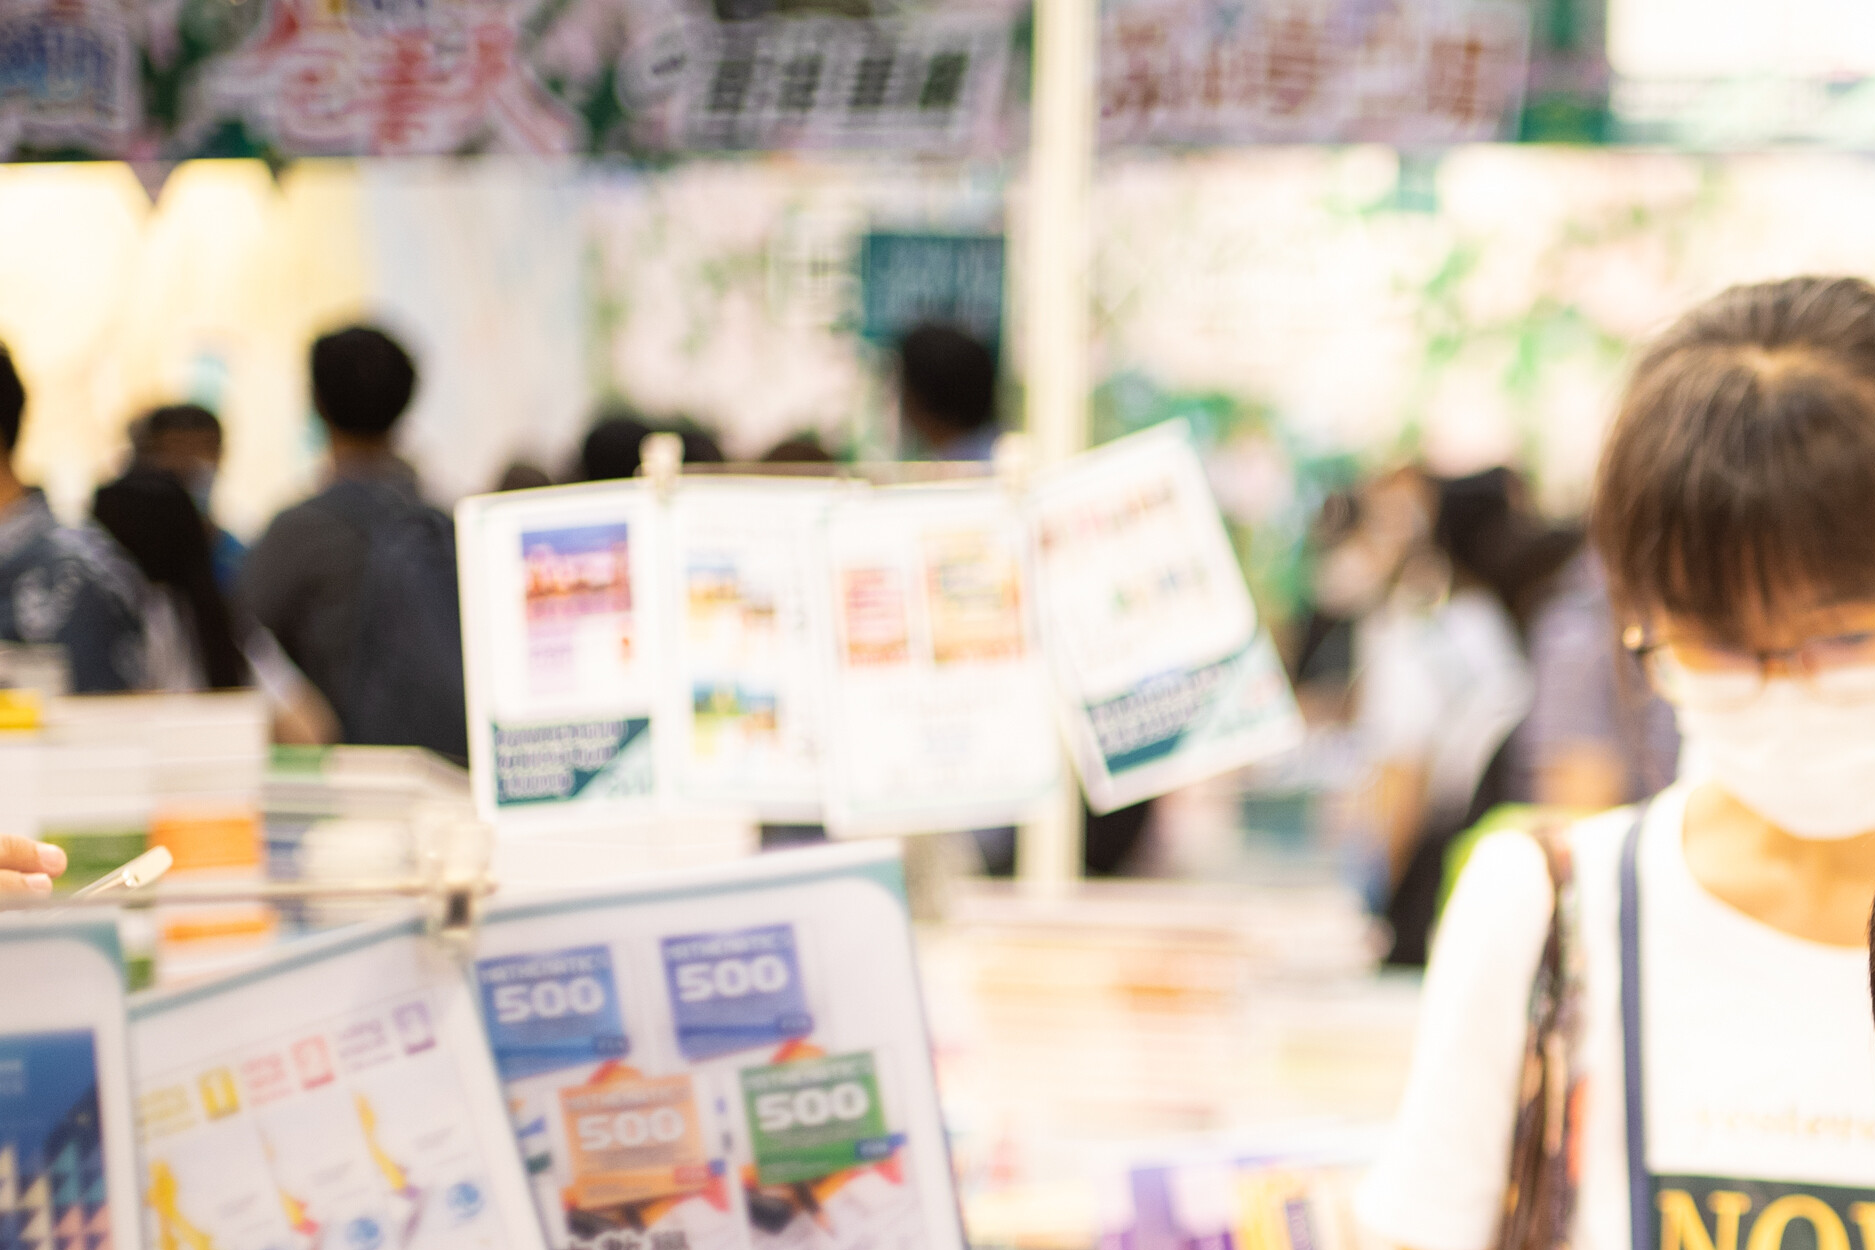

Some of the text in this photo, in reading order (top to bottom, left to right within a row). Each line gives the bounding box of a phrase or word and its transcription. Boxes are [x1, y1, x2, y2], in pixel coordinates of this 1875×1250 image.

[495, 976, 604, 1022] 500
[677, 955, 788, 1002] 500
[576, 1107, 685, 1151] 500
[756, 1082, 869, 1131] 500
